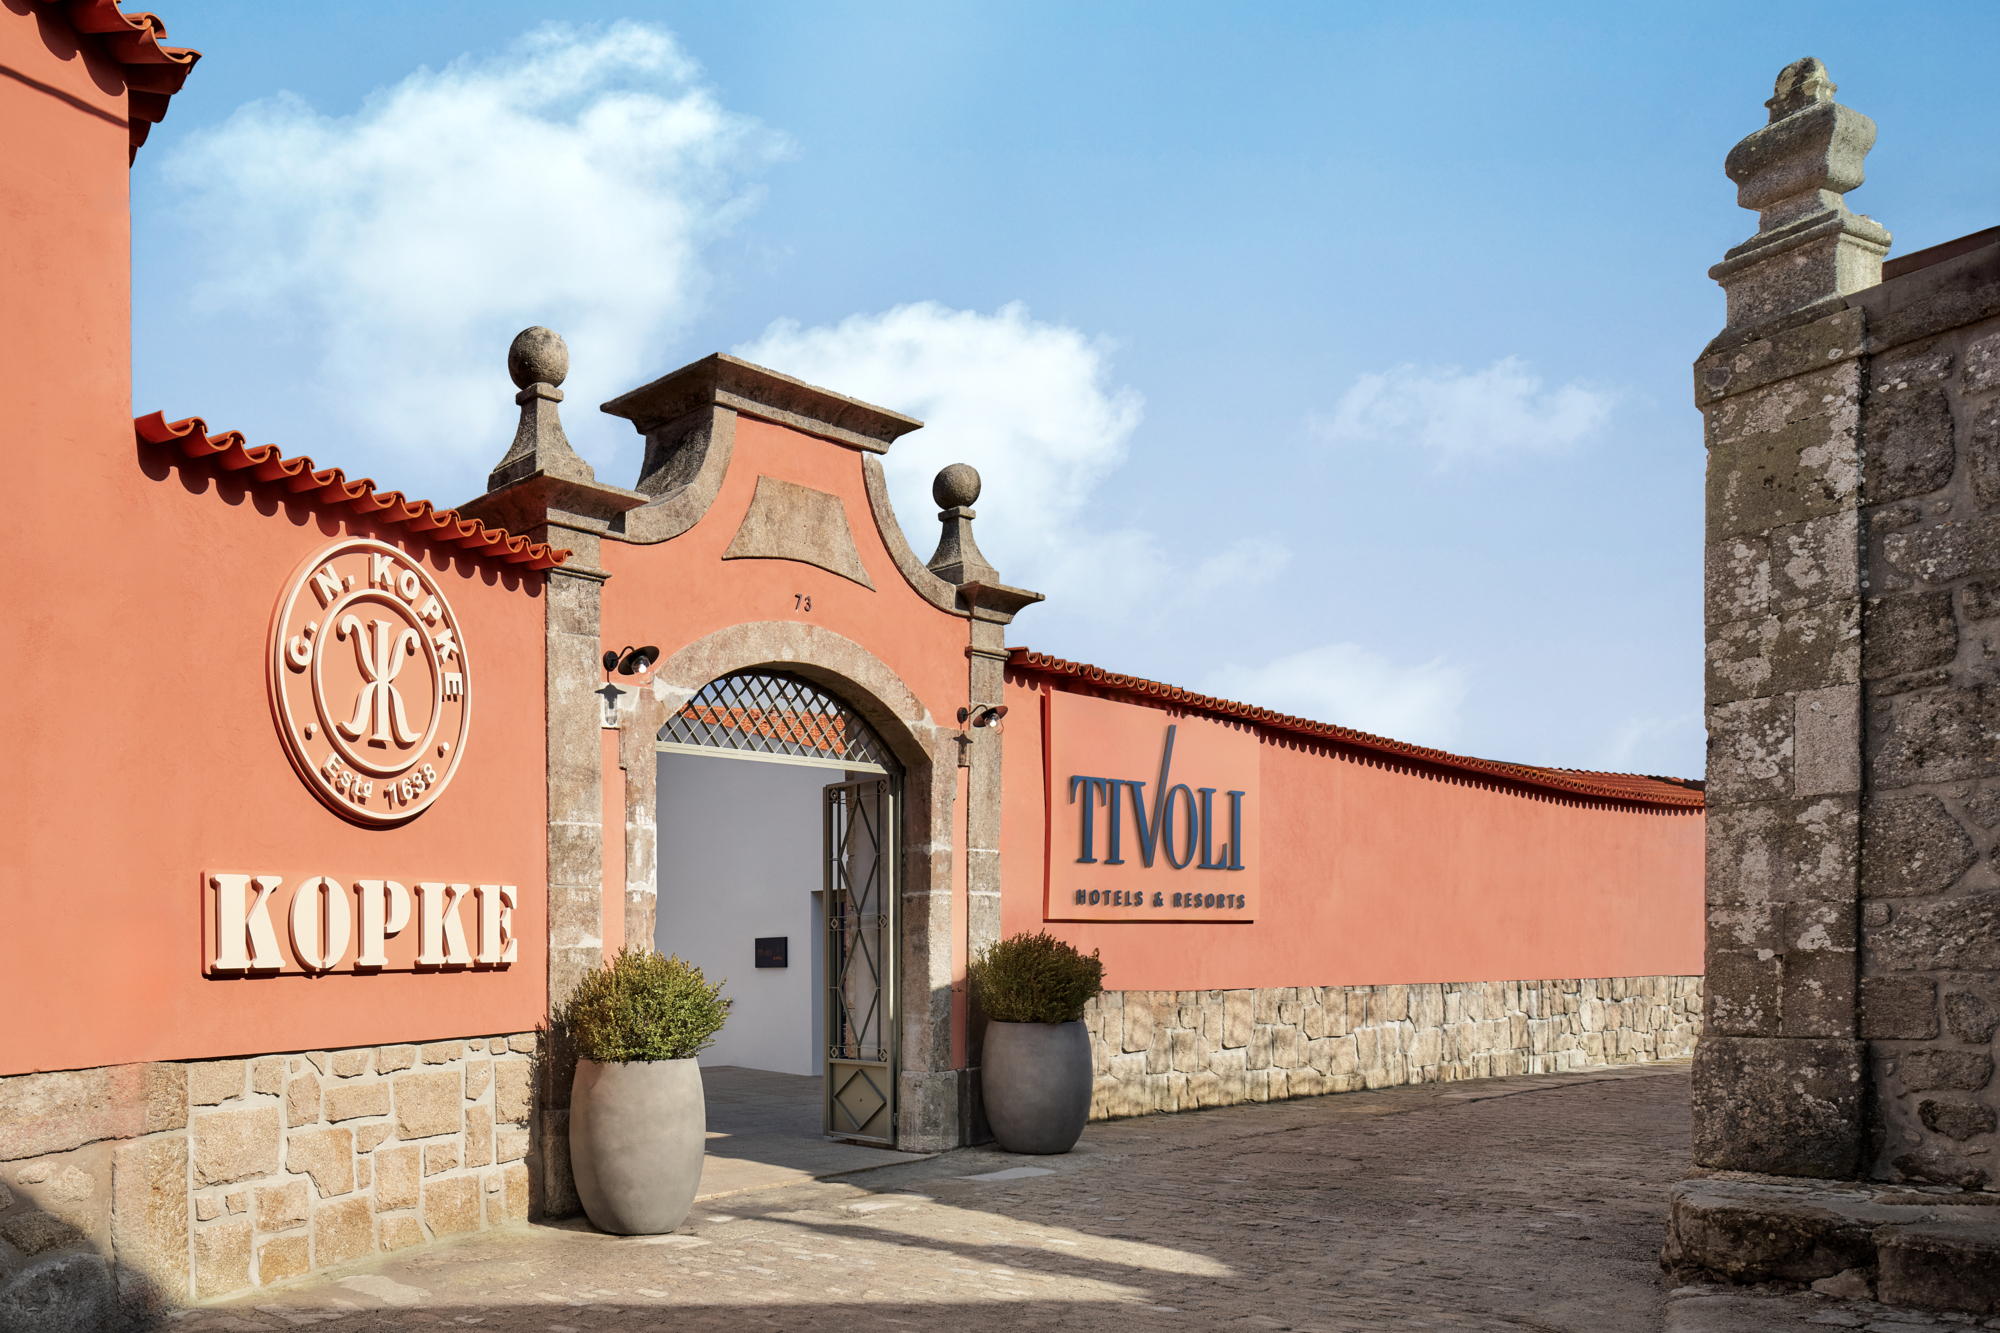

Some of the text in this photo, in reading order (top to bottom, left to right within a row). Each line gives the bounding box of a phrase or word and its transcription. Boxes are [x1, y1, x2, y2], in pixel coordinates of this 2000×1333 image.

[285, 552, 464, 697] C. N. KOPKE
[795, 593, 811, 612] 73
[385, 762, 437, 803] 1638
[1069, 724, 1246, 870] TIVOLI
[212, 873, 518, 969] KOPKE
[1075, 889, 1246, 909] HOTELS & RESORTS
